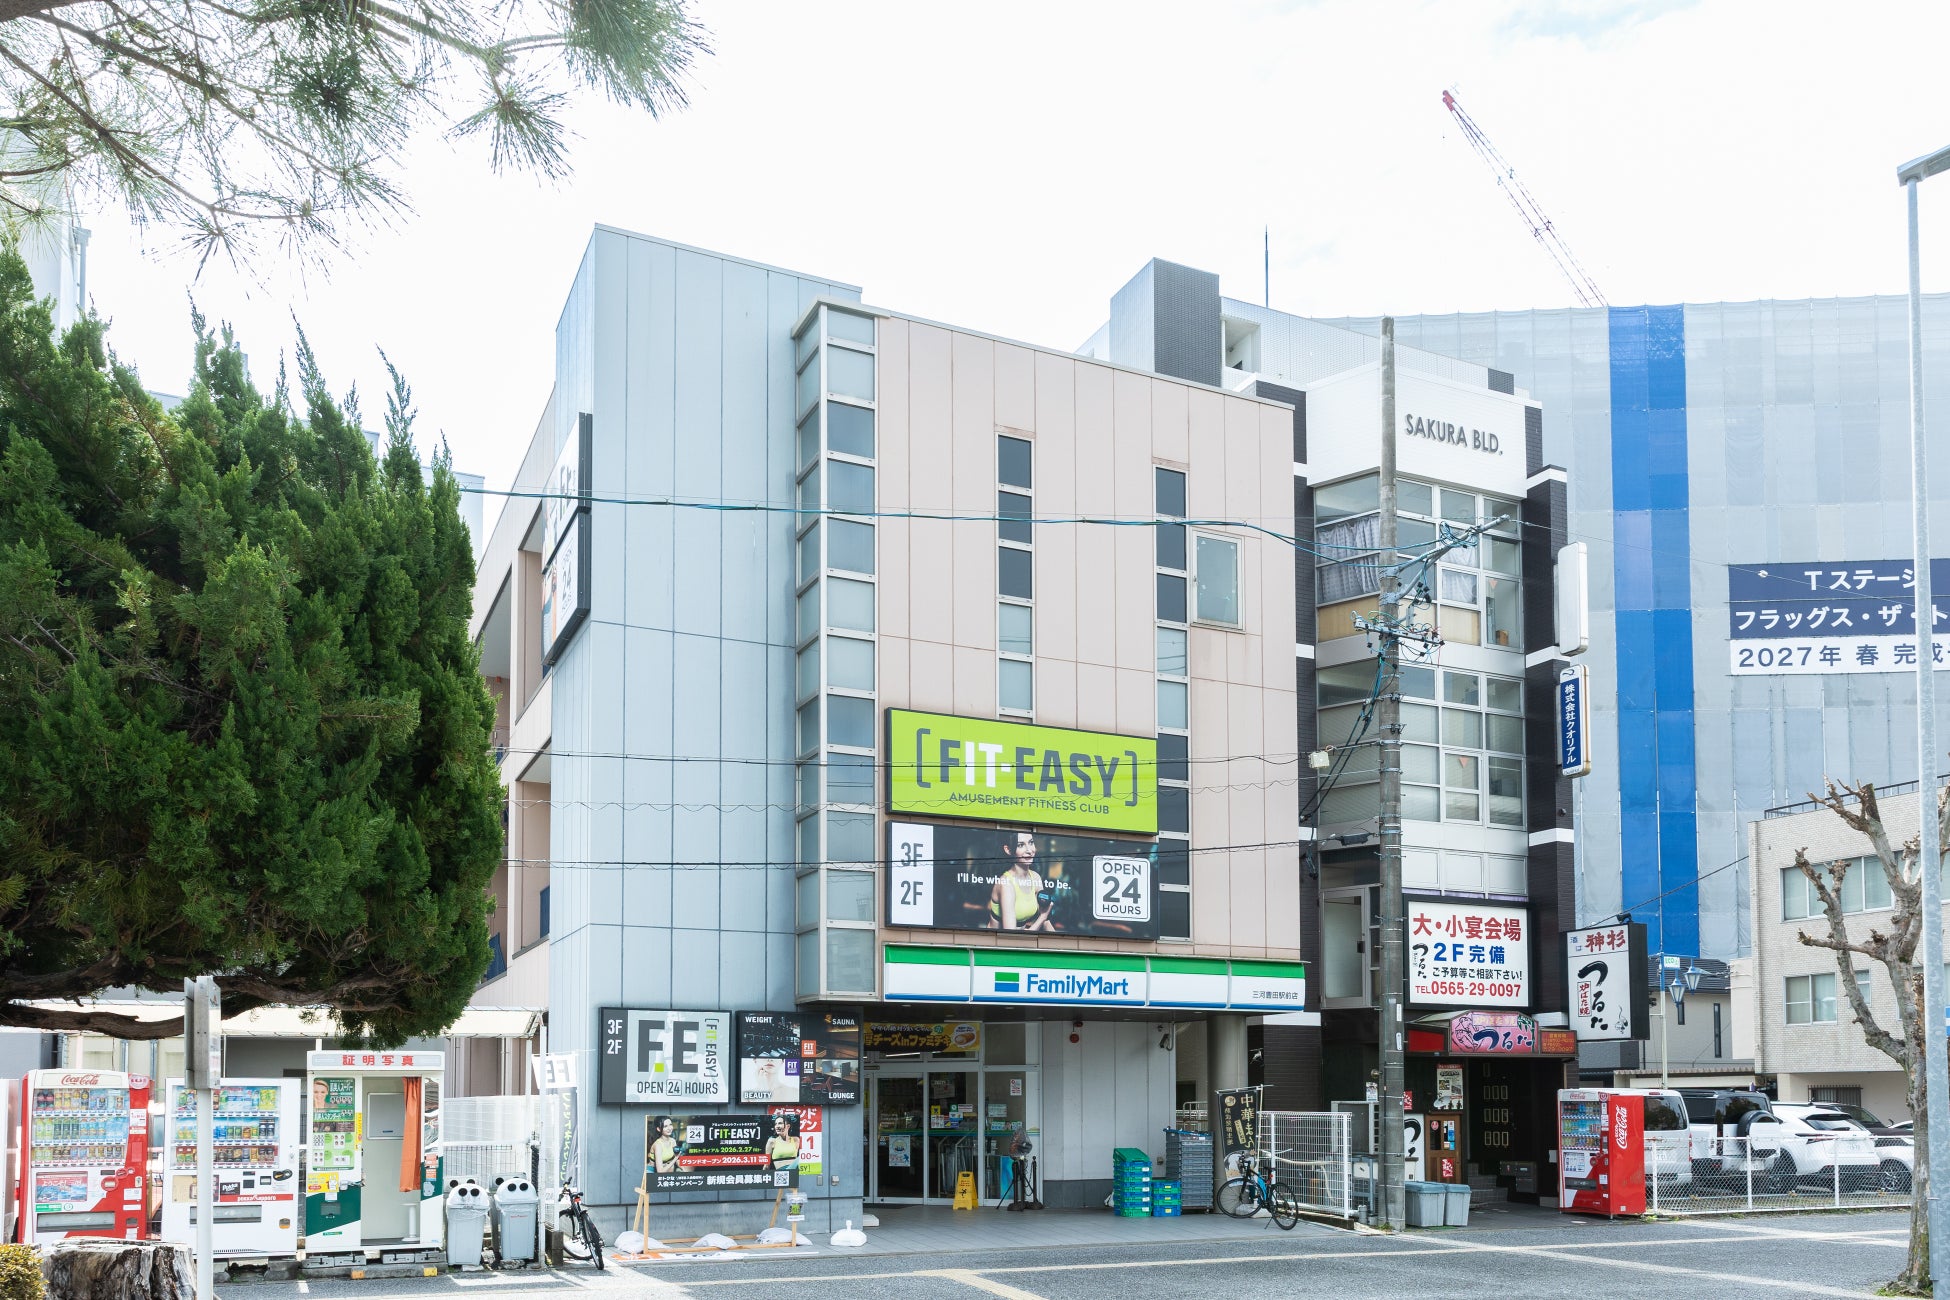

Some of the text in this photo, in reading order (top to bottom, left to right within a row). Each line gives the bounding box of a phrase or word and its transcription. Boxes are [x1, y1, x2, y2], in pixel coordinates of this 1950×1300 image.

[1405, 413, 1503, 456] SAKURA BLD.
[1738, 645, 1841, 667] 2027年
[1856, 644, 1879, 665] 春
[1564, 683, 1577, 765] 株式会社クオリアル
[950, 792, 1110, 815] AMUSEMENT FITNESS CLUB
[900, 842, 924, 868] 3F
[1102, 862, 1142, 875] OPEN
[957, 873, 970, 884] I'll
[971, 874, 984, 884] be
[985, 874, 1010, 885] what
[1044, 878, 1055, 888] to
[1056, 879, 1072, 890] be.
[900, 880, 923, 906] 2F
[1102, 876, 1142, 905] 24
[1102, 904, 1142, 915] HOURS
[1413, 913, 1522, 941] 大・小宴会場
[1585, 930, 1626, 953] 神杉
[1027, 973, 1129, 998] FamilyMart
[1252, 990, 1299, 1000] 三河豊田駅前店
[607, 1019, 623, 1035] 3F
[745, 1016, 773, 1024] WEIGHT
[832, 1018, 855, 1026] SAUNA
[607, 1039, 623, 1055] 2F
[803, 1043, 815, 1051] FIT
[342, 1054, 414, 1067] 証明写真
[787, 1061, 798, 1069] FIT
[803, 1061, 815, 1069] FIT
[637, 1081, 718, 1095] OPEN 24 HOURS
[689, 1130, 702, 1139] 24
[1615, 1105, 1628, 1150] Coca-Cola
[707, 1173, 772, 1186] 新規会員募集中
